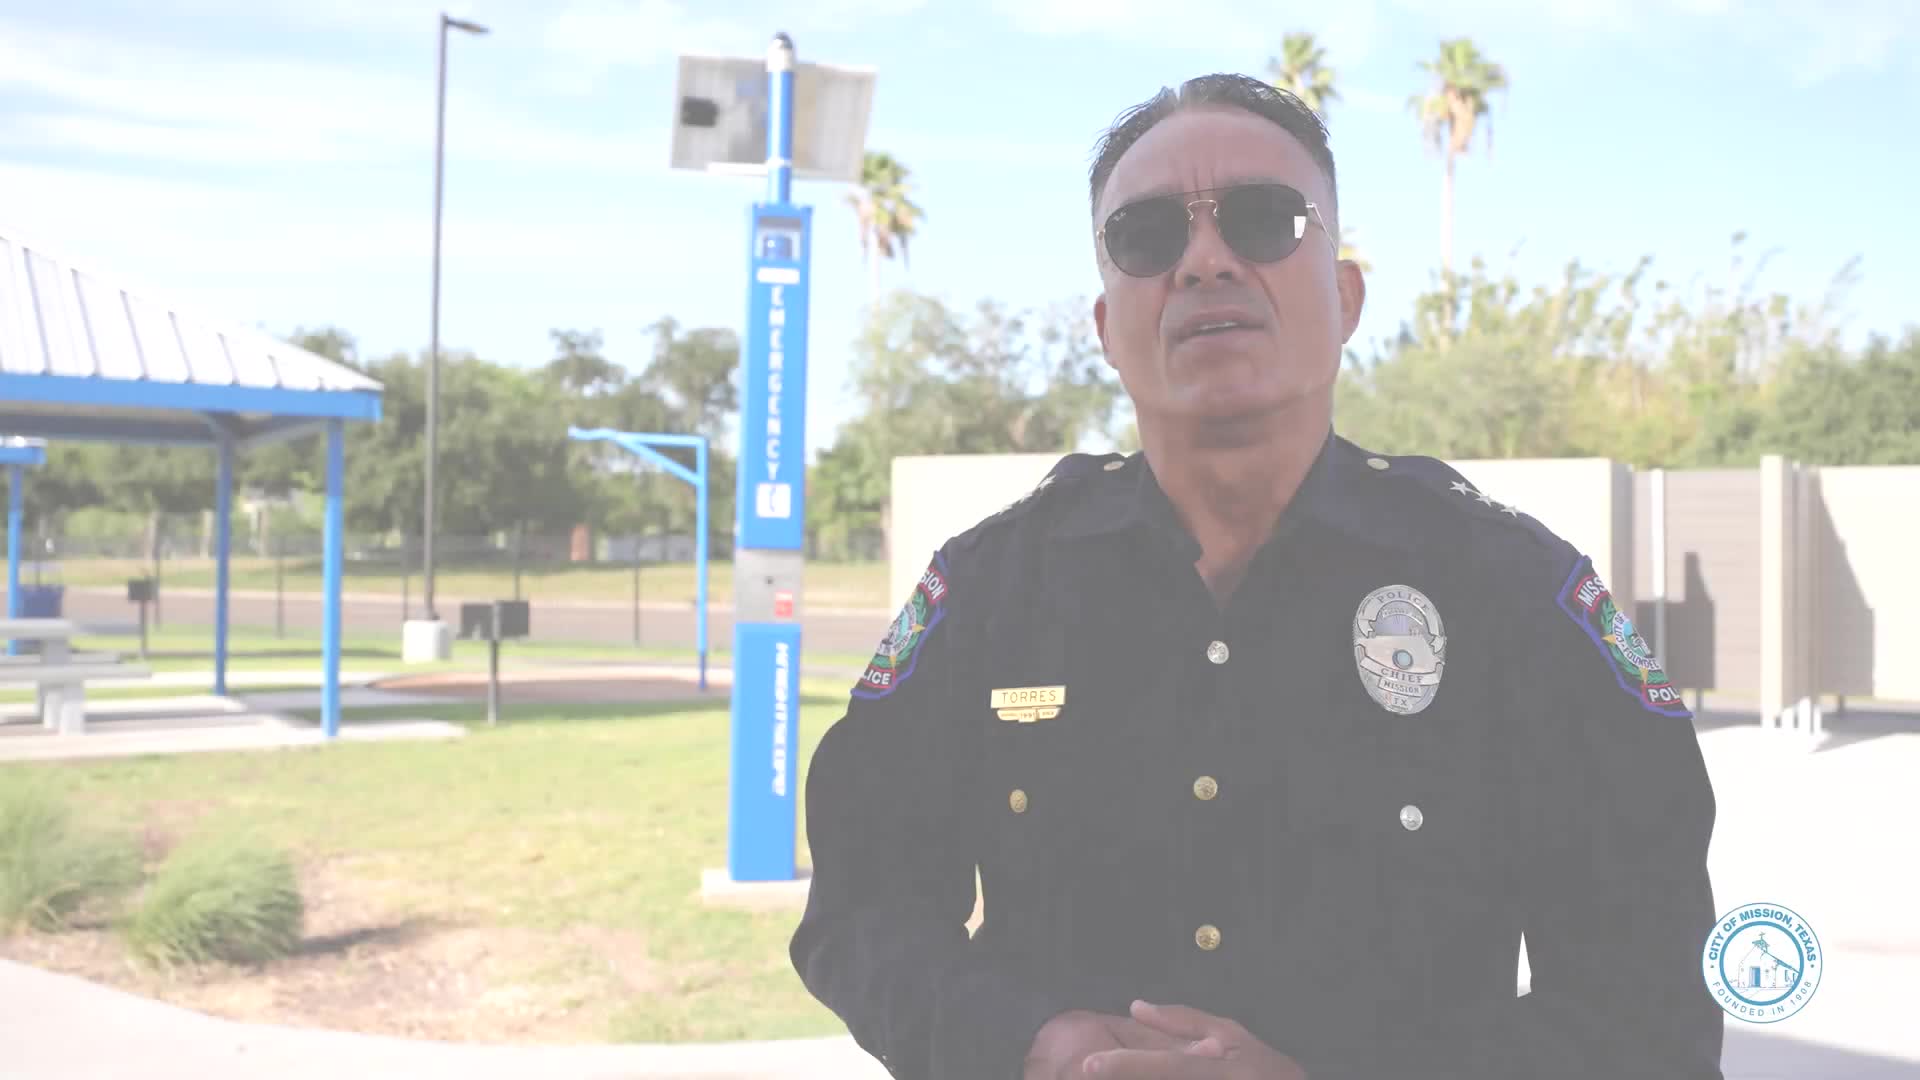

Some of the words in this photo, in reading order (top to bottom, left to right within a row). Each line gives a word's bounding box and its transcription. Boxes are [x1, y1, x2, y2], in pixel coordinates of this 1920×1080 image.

[1377, 591, 1430, 610] POLICE
[1381, 668, 1424, 683] CHIEF
[1384, 680, 1420, 693] MISSION
[1002, 689, 1057, 704] TORRES
[1393, 696, 1408, 706] TX
